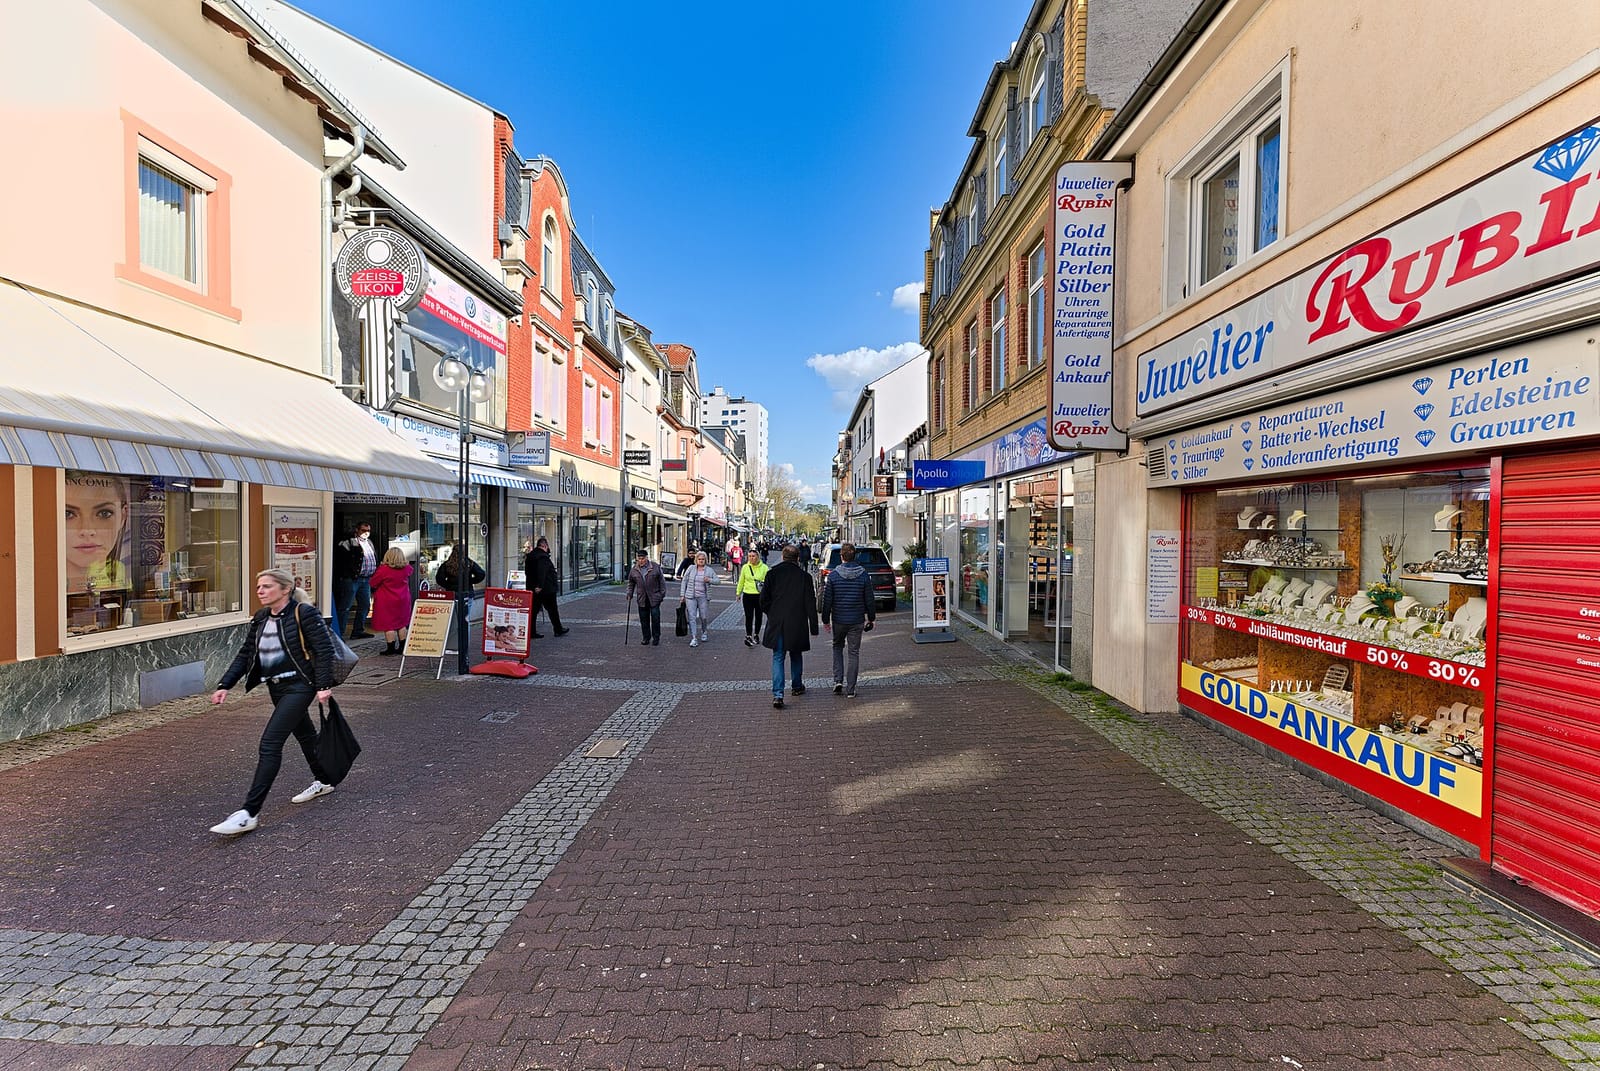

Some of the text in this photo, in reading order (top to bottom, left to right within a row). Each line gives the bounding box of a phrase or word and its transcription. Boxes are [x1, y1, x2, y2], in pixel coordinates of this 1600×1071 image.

[1058, 177, 1114, 191] Juwelier
[1057, 194, 1113, 212] RUBIN
[1063, 223, 1106, 239] Gold
[1059, 242, 1112, 257] Platin
[1057, 260, 1113, 275] Perlen
[357, 272, 398, 281] ZEISS
[360, 283, 395, 293] IKON
[1057, 278, 1111, 294] Silber
[1064, 297, 1100, 307] Uhren
[1056, 309, 1109, 320] Trauringe
[436, 304, 505, 351] Partner-Vertragswerkstatt
[1054, 320, 1112, 329] Reparaturen
[1055, 329, 1110, 339] Anfertigung
[1064, 355, 1101, 368] Gold
[1138, 320, 1274, 403] Juwelier
[1055, 370, 1112, 384] Ankauf
[1448, 357, 1529, 390] Perlen
[1449, 376, 1590, 418] Edelsteine
[1054, 404, 1110, 418] Juwelier
[1258, 401, 1344, 432] Reparaturen
[402, 417, 454, 440] Oberurseler
[1054, 420, 1109, 438] RUBIN
[1450, 410, 1575, 444] Gravuren
[1181, 424, 1234, 449] Goldankauf
[1182, 448, 1225, 465] Trauringe
[1261, 437, 1400, 470] Sonderanfertigung
[916, 468, 949, 480] Apollo
[1183, 466, 1208, 480] Silber
[558, 466, 595, 498] fielmann
[1248, 621, 1347, 655] Jubiläumsverkauf
[1199, 672, 1457, 797] GOLD-ANKAUF
